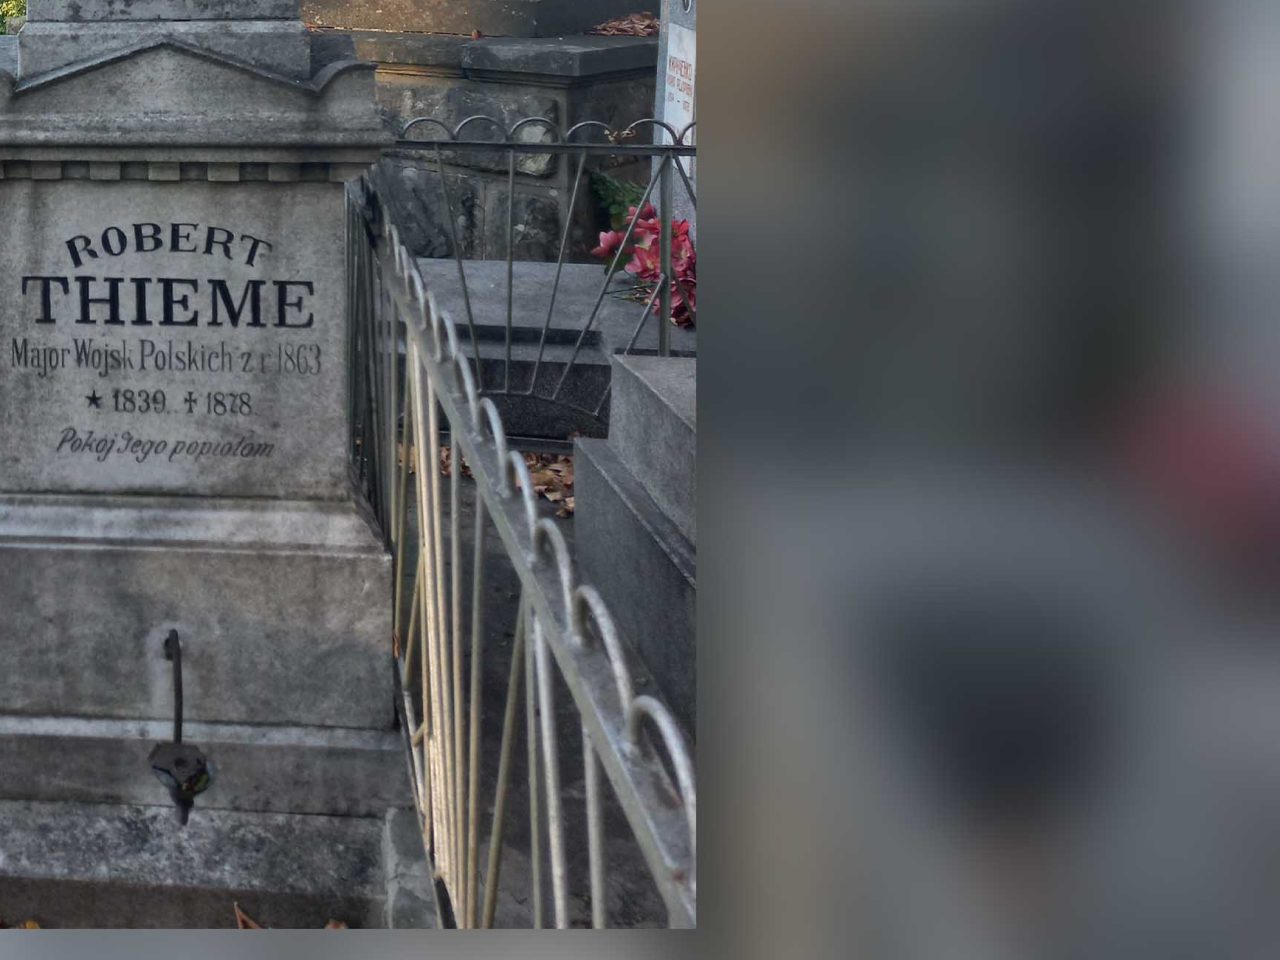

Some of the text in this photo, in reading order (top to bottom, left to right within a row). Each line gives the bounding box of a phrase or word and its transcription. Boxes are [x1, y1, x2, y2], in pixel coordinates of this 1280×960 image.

[65, 222, 273, 269] ROBERT
[21, 276, 315, 329] THIEME
[12, 338, 70, 378] Major
[73, 338, 134, 378] Wojsk
[138, 339, 232, 373] Polskich
[241, 351, 254, 373] z
[278, 342, 321, 376] 1863
